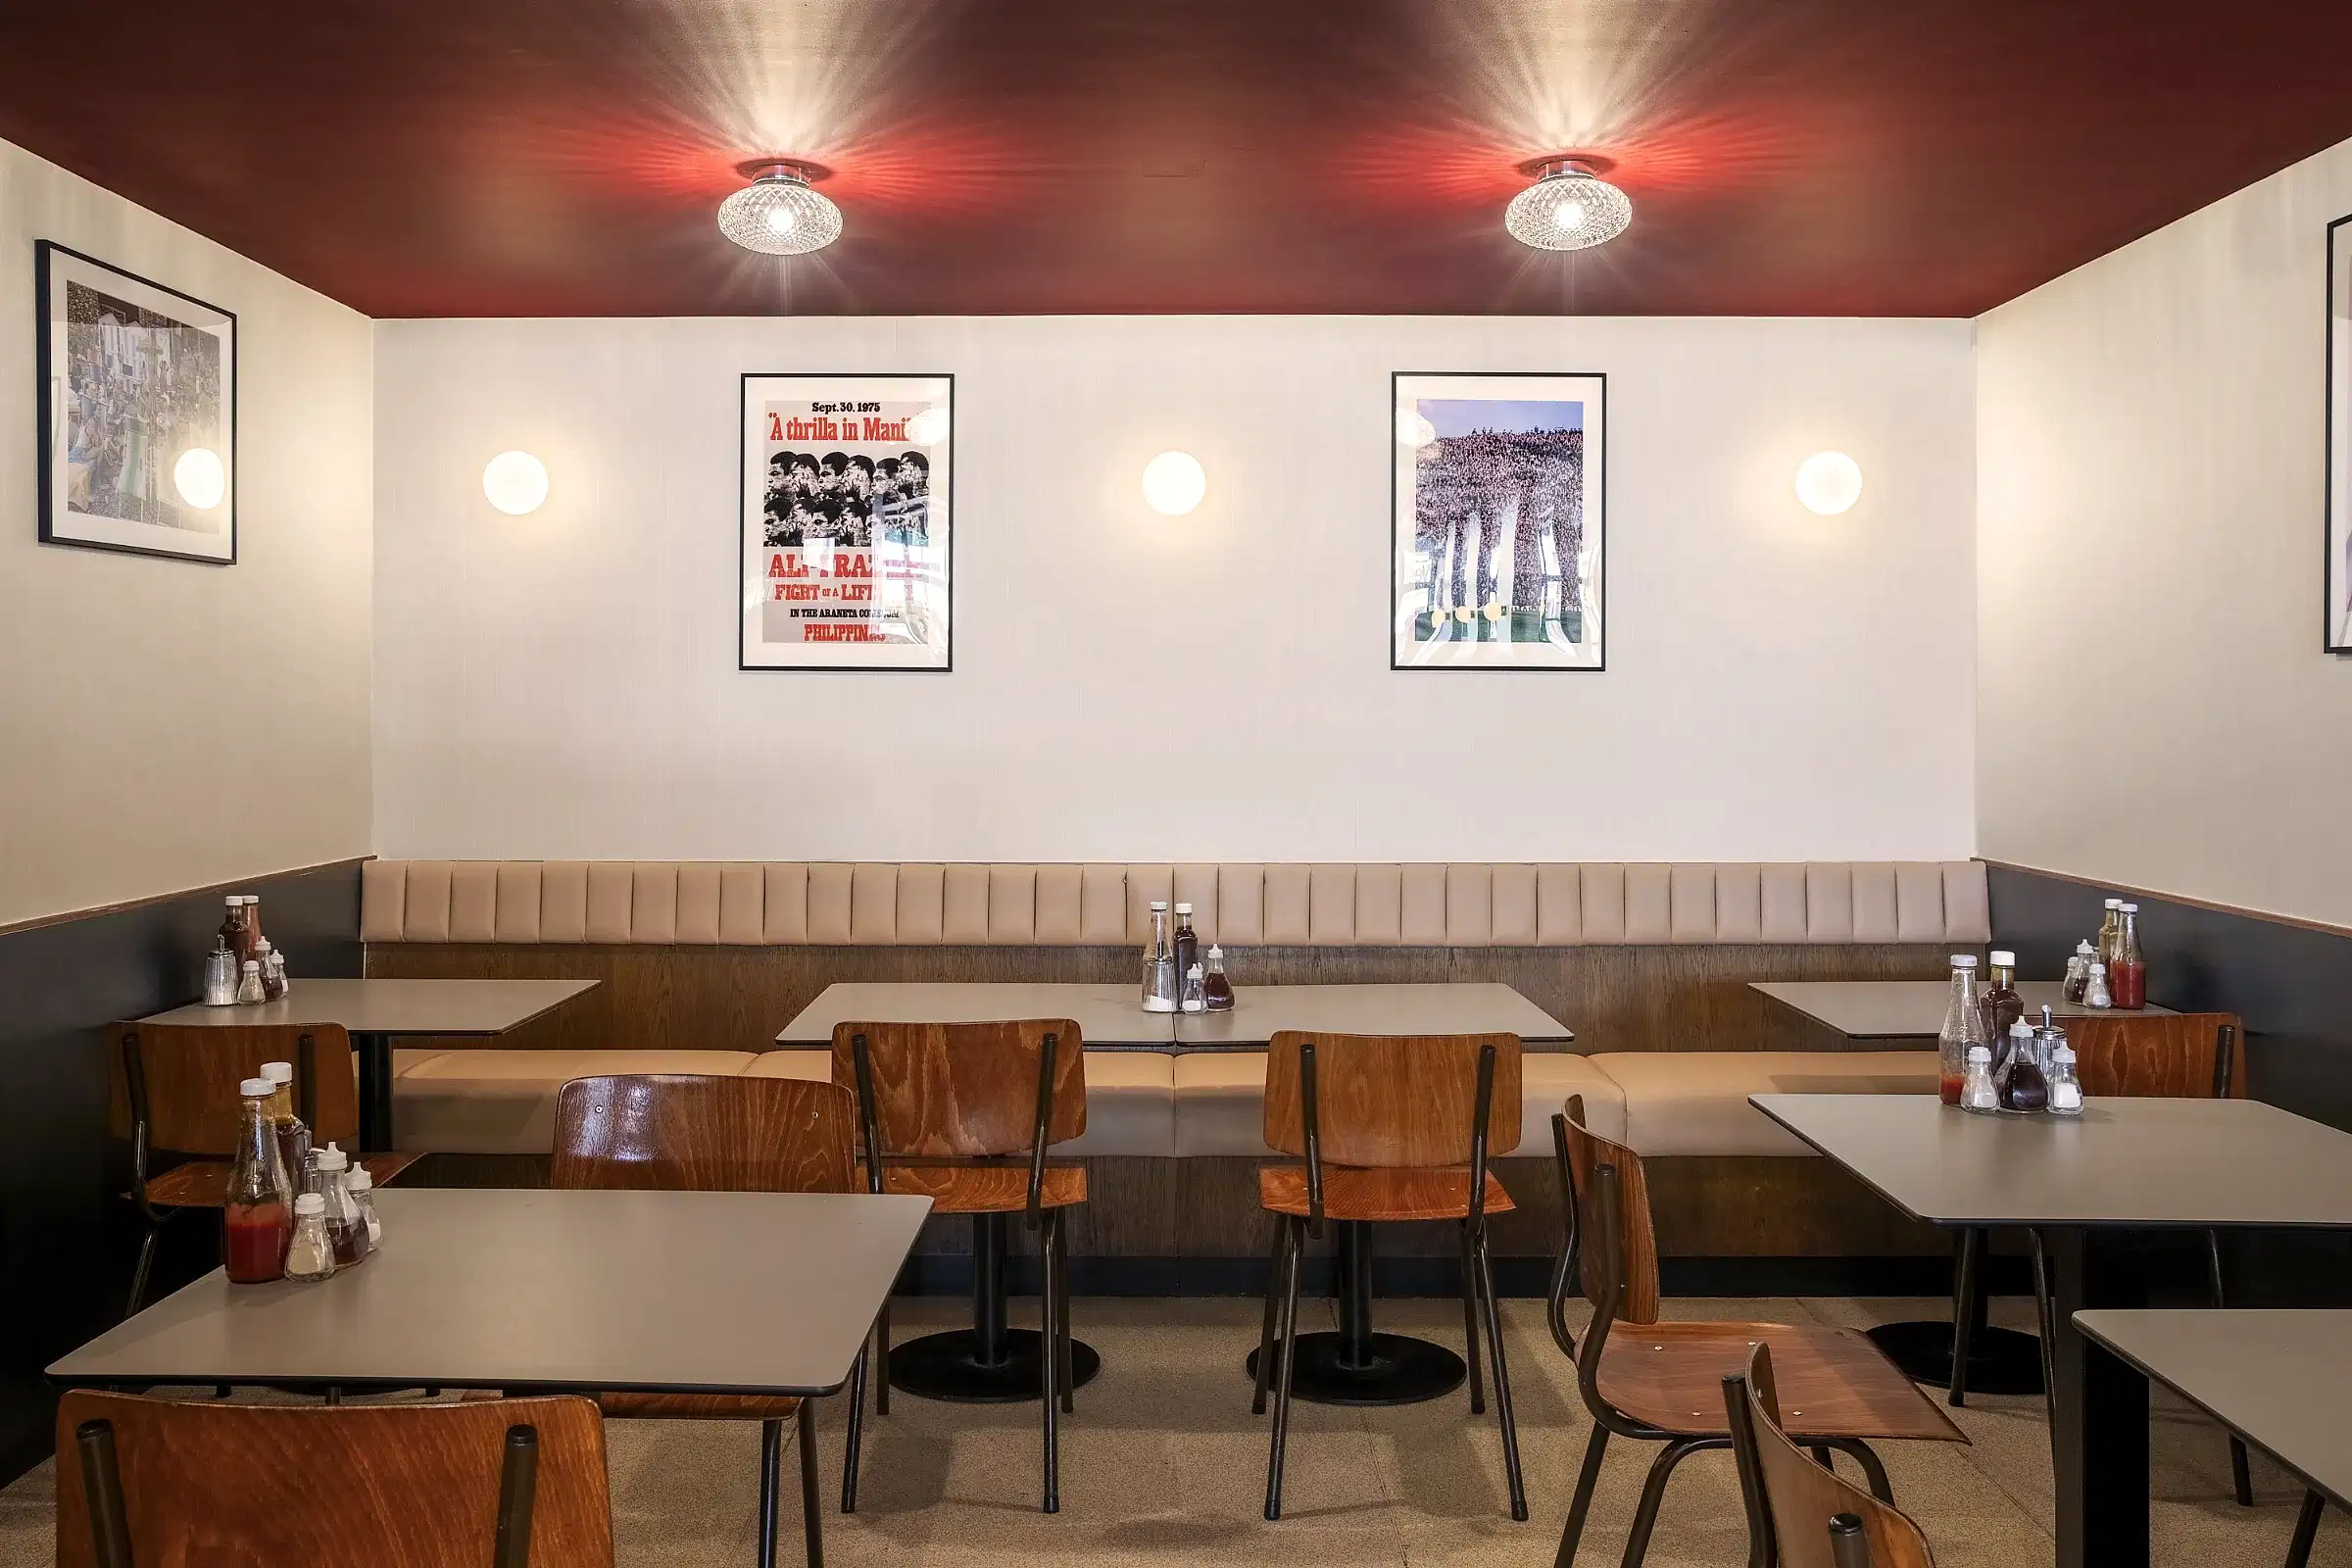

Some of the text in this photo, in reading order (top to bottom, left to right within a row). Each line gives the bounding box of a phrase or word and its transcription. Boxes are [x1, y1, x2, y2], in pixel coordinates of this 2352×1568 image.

[811, 402, 839, 415] Sept.
[857, 402, 881, 413] 1975
[786, 417, 838, 440] thrilla
[842, 417, 858, 440] in
[774, 583, 820, 601] FIGHT
[821, 588, 832, 597] OF
[832, 588, 839, 597] A
[790, 609, 800, 618] IN
[801, 609, 818, 618] THE
[819, 609, 858, 618] ARANETA
